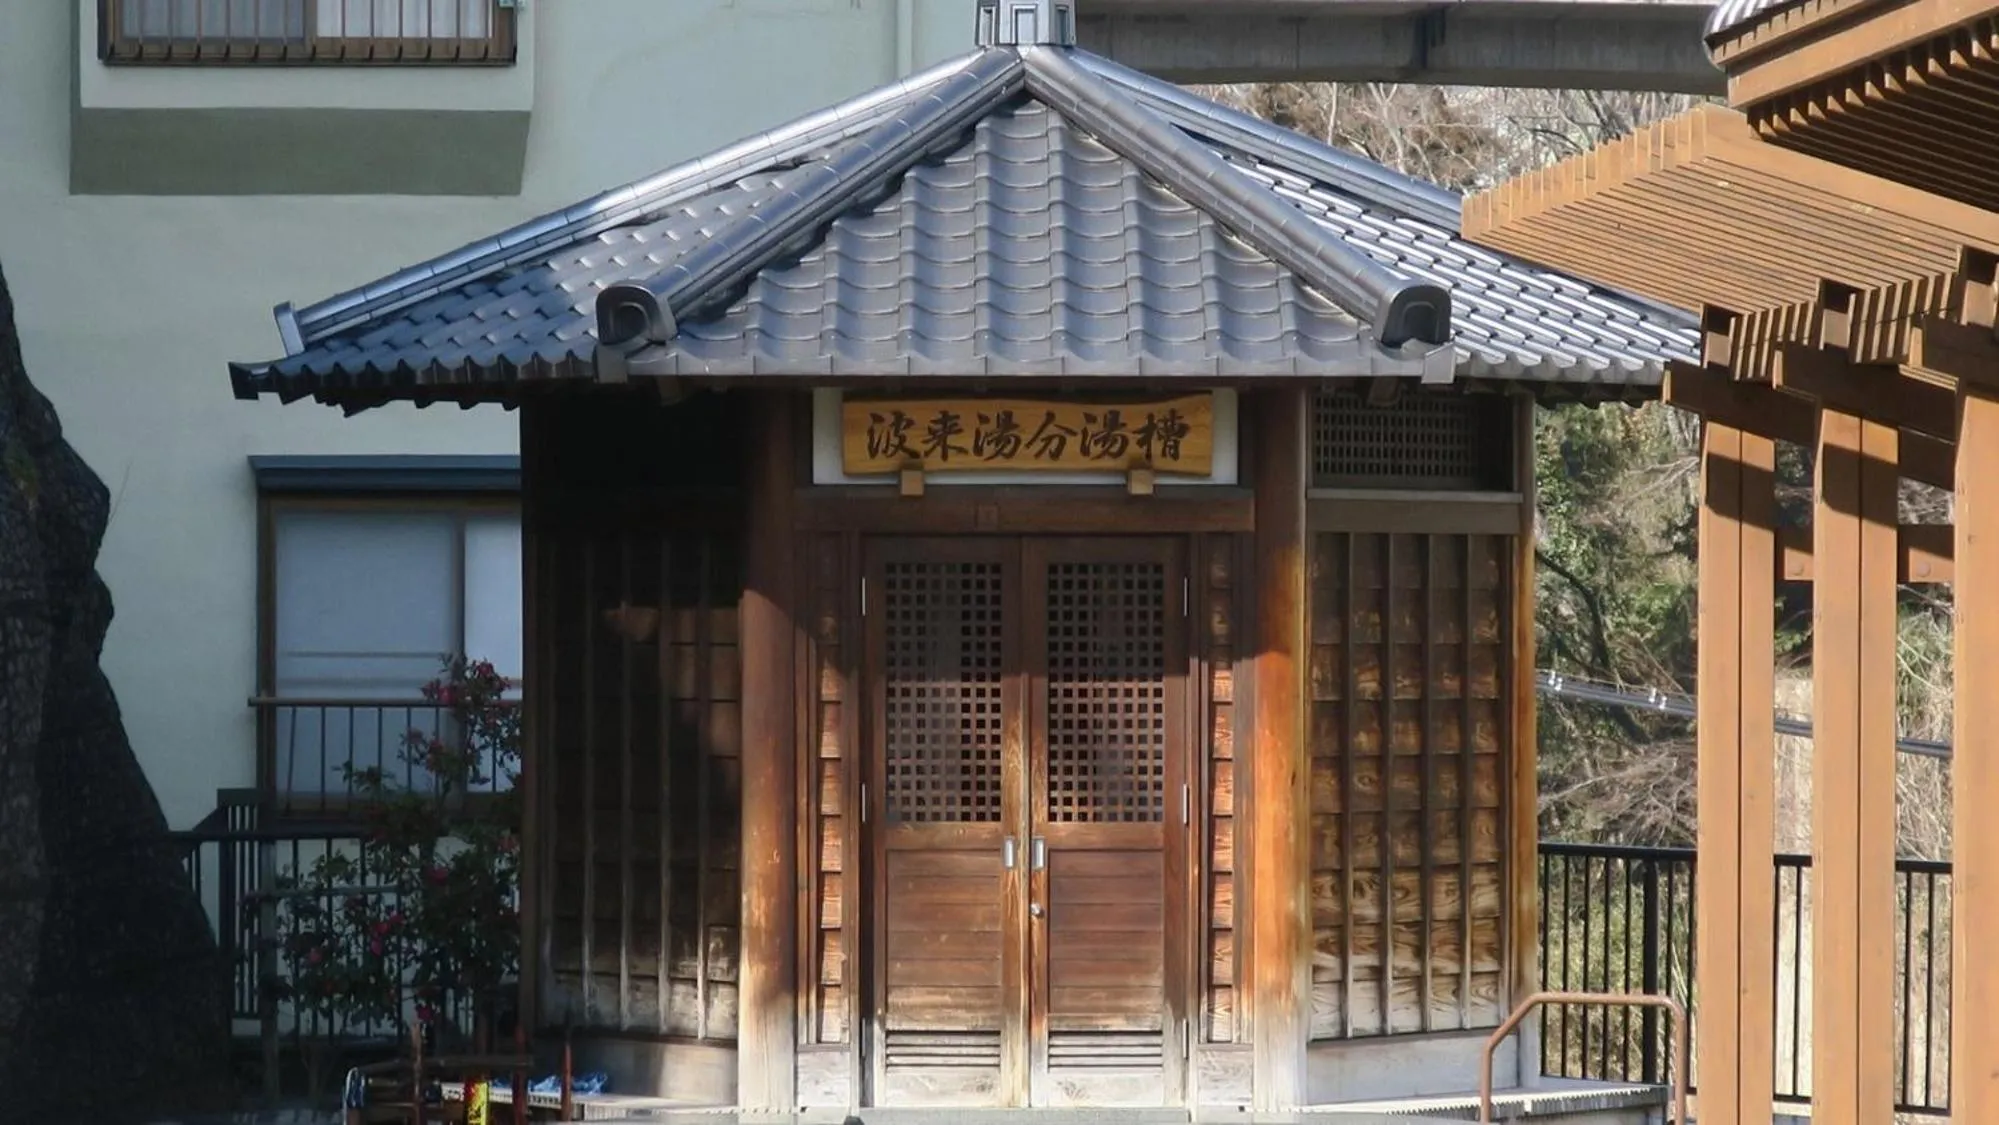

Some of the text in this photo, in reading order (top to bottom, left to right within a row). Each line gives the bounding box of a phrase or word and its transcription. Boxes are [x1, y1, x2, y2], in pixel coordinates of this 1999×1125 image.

[867, 408, 1190, 461] 波来湯分湯槽
